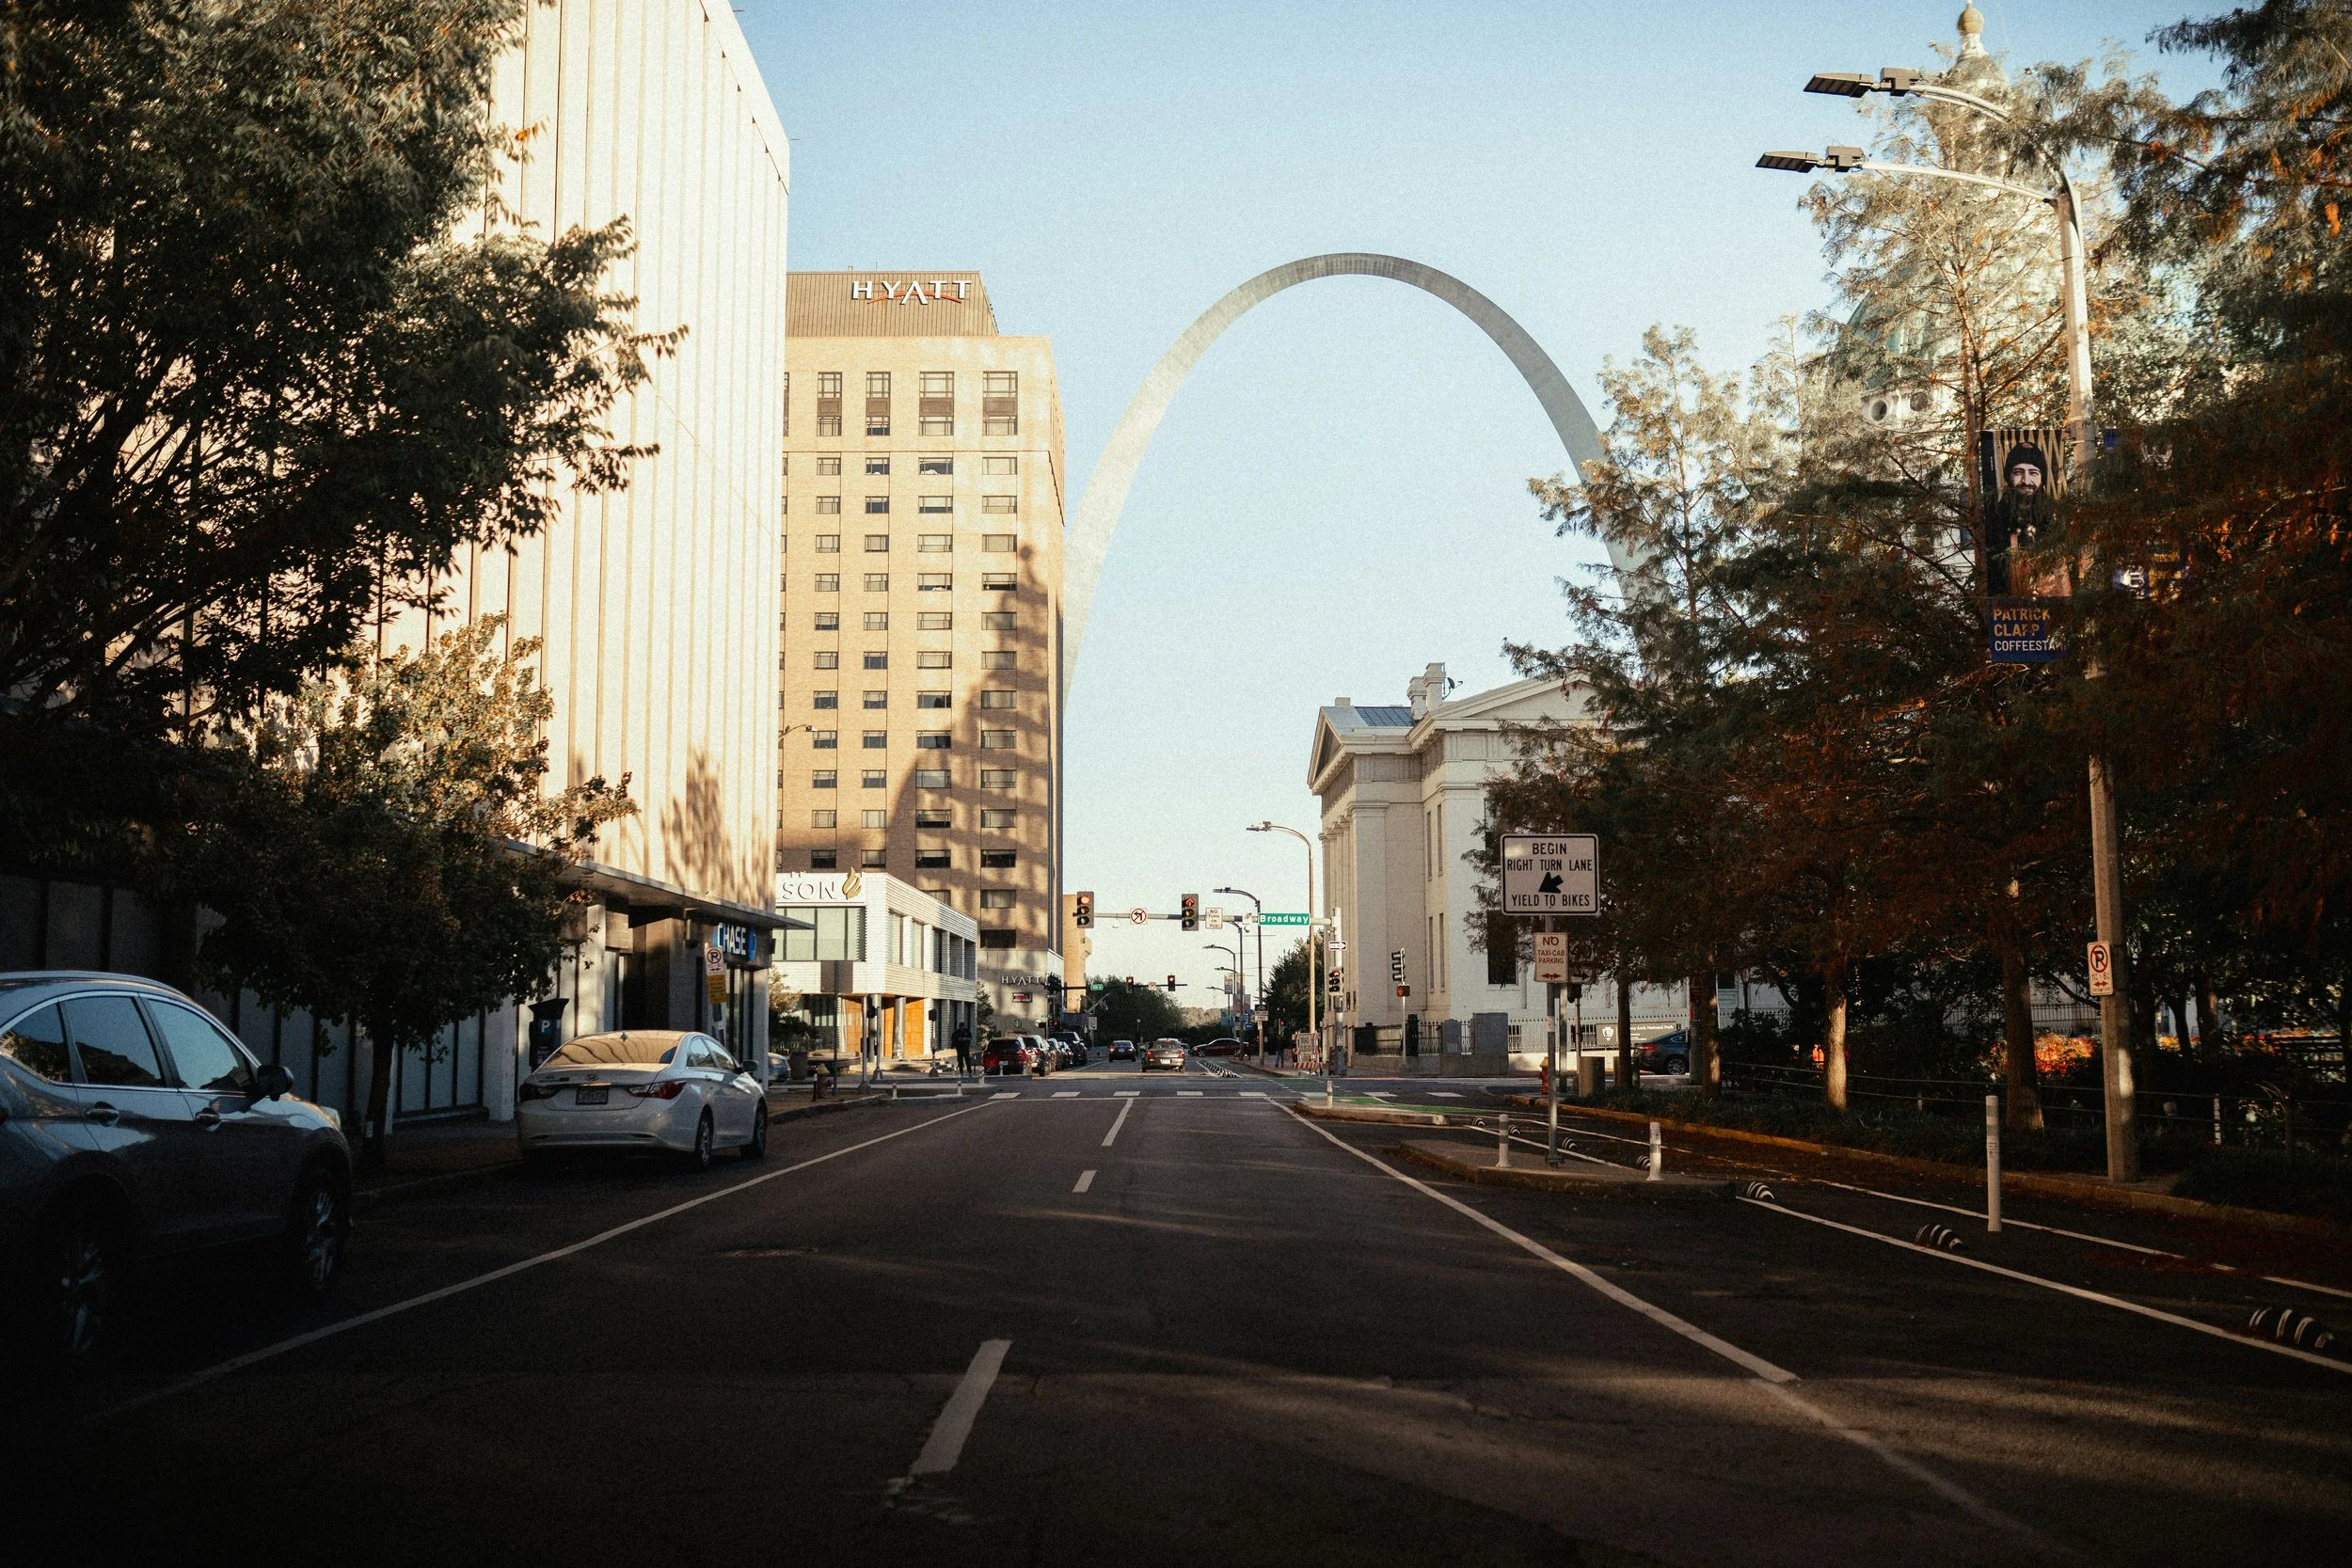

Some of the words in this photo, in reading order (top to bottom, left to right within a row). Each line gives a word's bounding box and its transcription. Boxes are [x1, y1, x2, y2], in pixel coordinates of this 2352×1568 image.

[852, 280, 971, 305] HYATT
[1993, 608, 2051, 621] PATRICK
[1532, 843, 1567, 854] BEGIN
[1507, 860, 1534, 871] RIGHT
[1540, 860, 1562, 871] TURN
[1569, 860, 1592, 871] LANE
[782, 881, 836, 899] SON
[1512, 895, 1539, 907] YIELD
[1545, 895, 1556, 907] TO
[1563, 895, 1590, 907] BIKES
[1260, 914, 1309, 925] Broadway
[717, 922, 746, 956] CHASE
[1542, 937, 1559, 946] NO
[1001, 975, 1041, 986] HYATT
